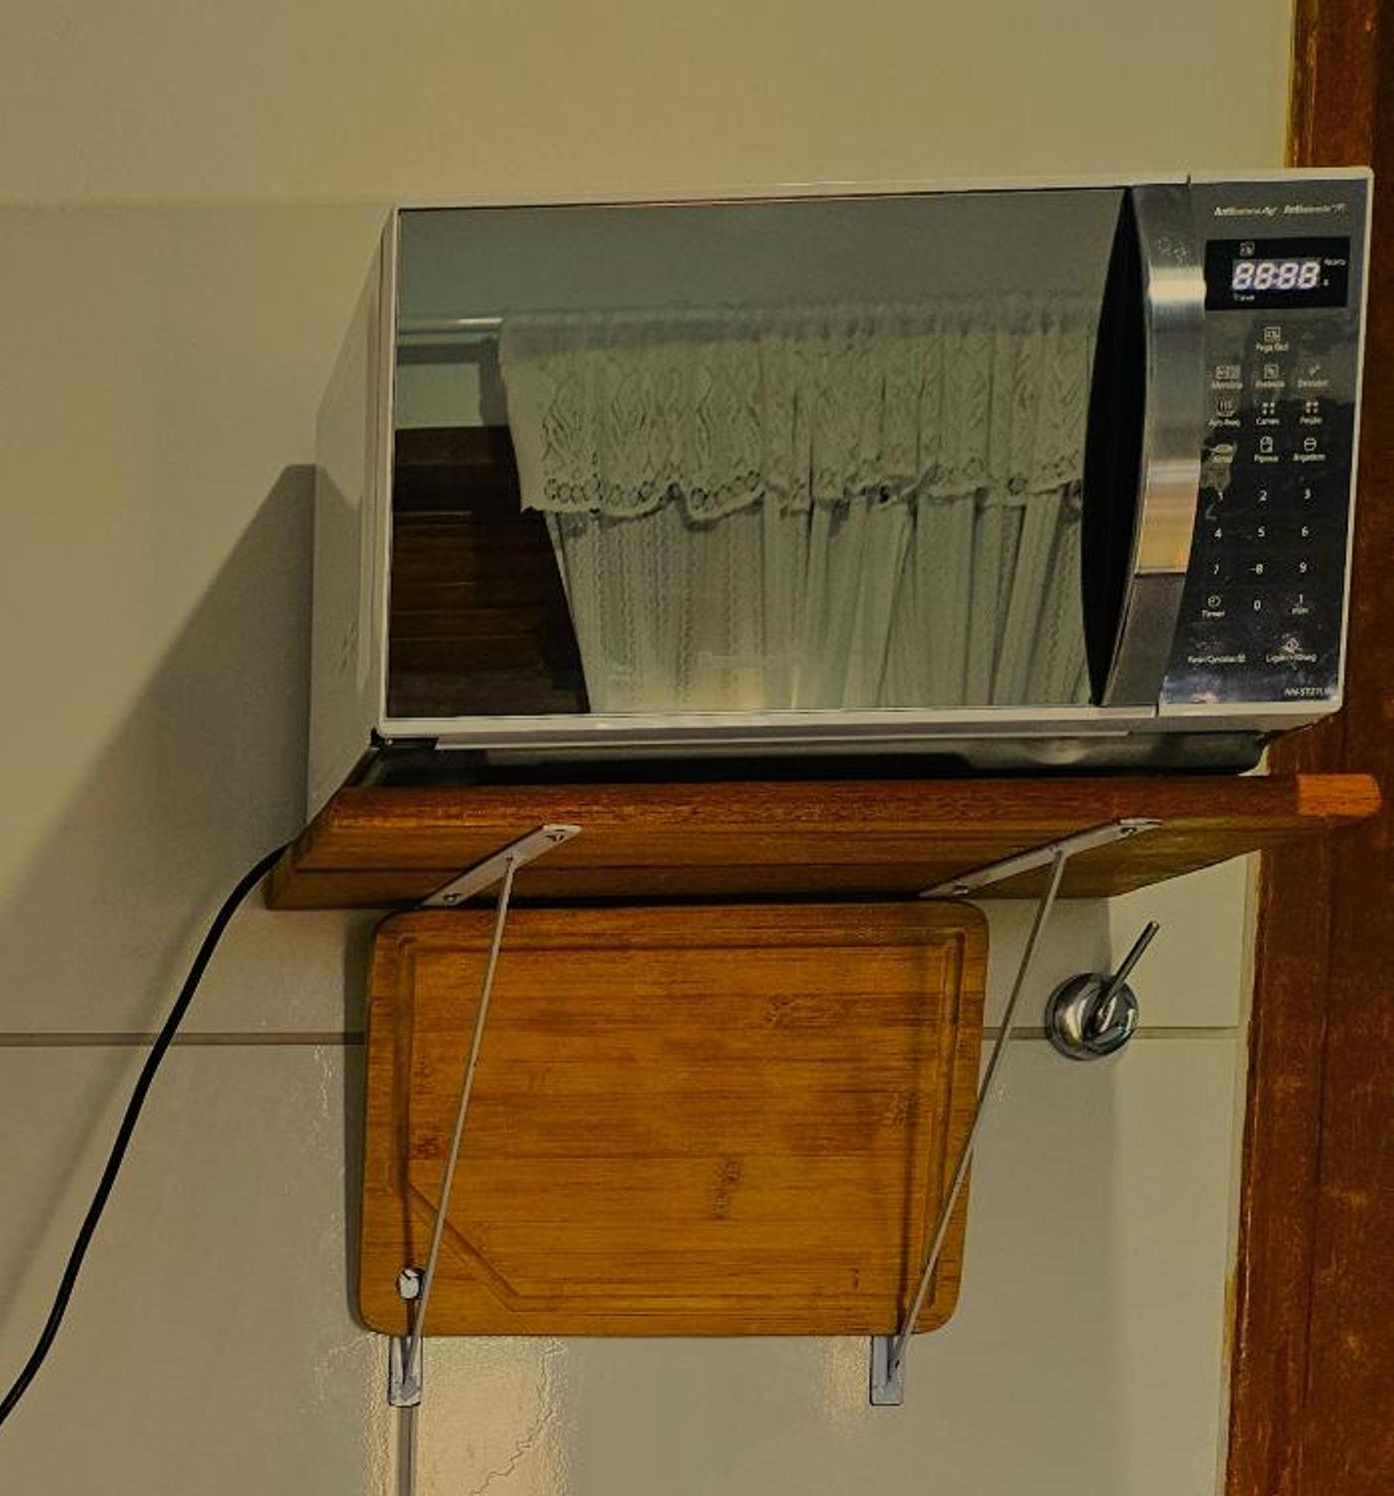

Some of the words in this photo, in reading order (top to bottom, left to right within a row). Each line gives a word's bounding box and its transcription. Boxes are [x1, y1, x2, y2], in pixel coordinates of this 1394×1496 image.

[1259, 490, 1267, 501] 2
[1304, 489, 1311, 500] 3
[1214, 528, 1222, 539] 4
[1258, 527, 1265, 537] 5
[1302, 526, 1309, 537] 6
[1256, 564, 1263, 574] 8
[1299, 562, 1307, 573] 9
[1254, 600, 1261, 610] 0
